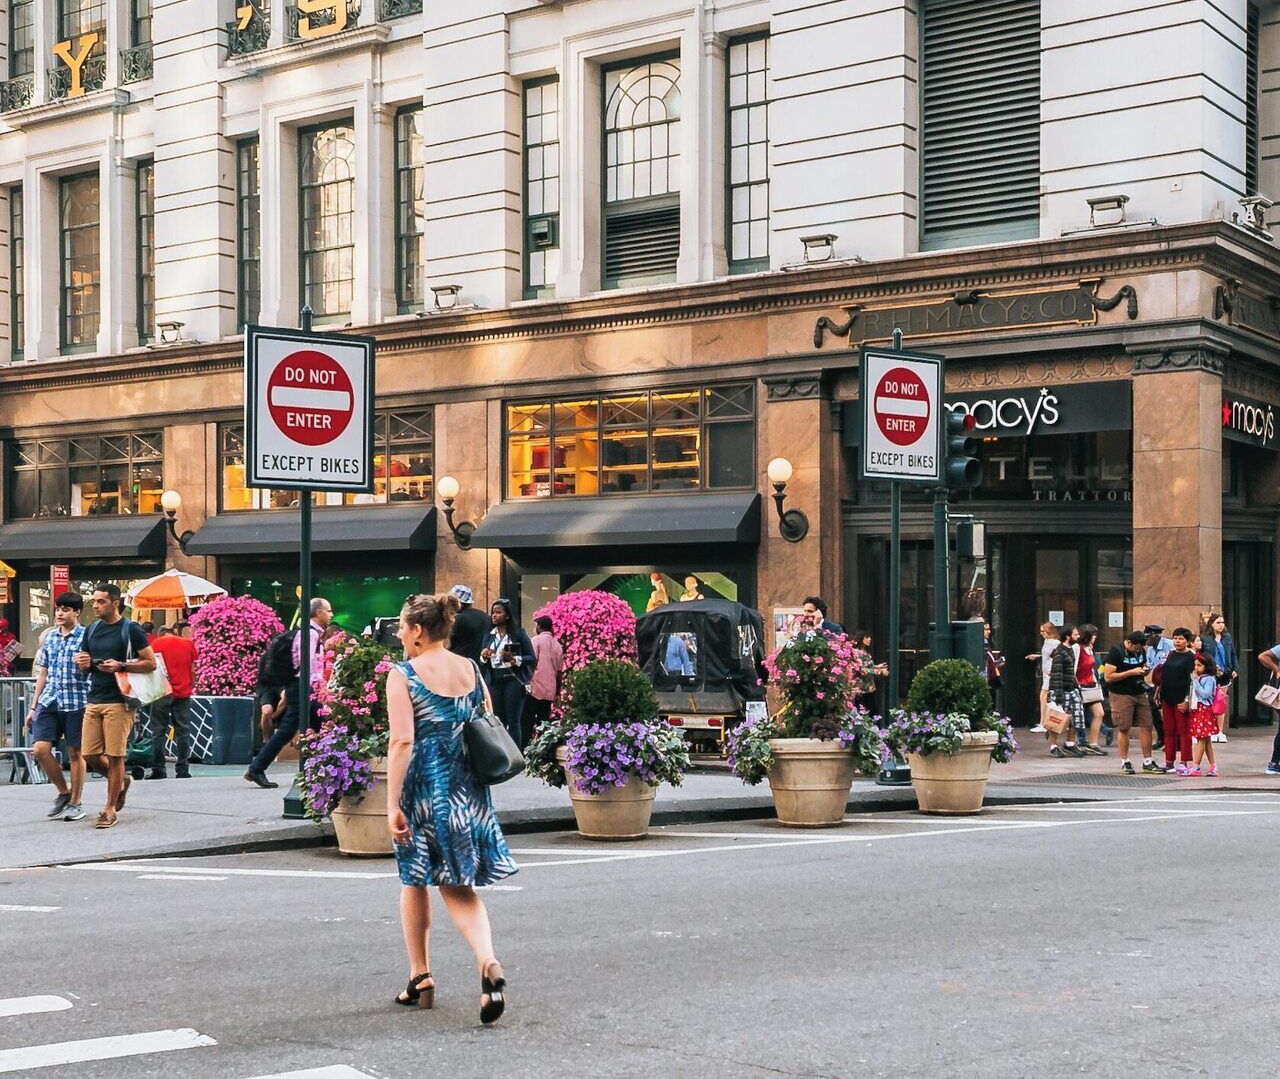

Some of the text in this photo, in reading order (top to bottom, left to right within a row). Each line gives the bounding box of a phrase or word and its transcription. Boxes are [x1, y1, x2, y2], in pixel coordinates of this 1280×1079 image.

[285, 367, 337, 385] DO NOT
[885, 381, 919, 396] DO NOT
[286, 412, 332, 429] ENTER
[886, 418, 916, 432] ENTER
[262, 454, 360, 474] EXCEPT BIKES
[871, 451, 934, 469] EXCEPT BIKES
[989, 457, 1132, 480] TELL
[1032, 490, 1132, 502] TRATTOR
